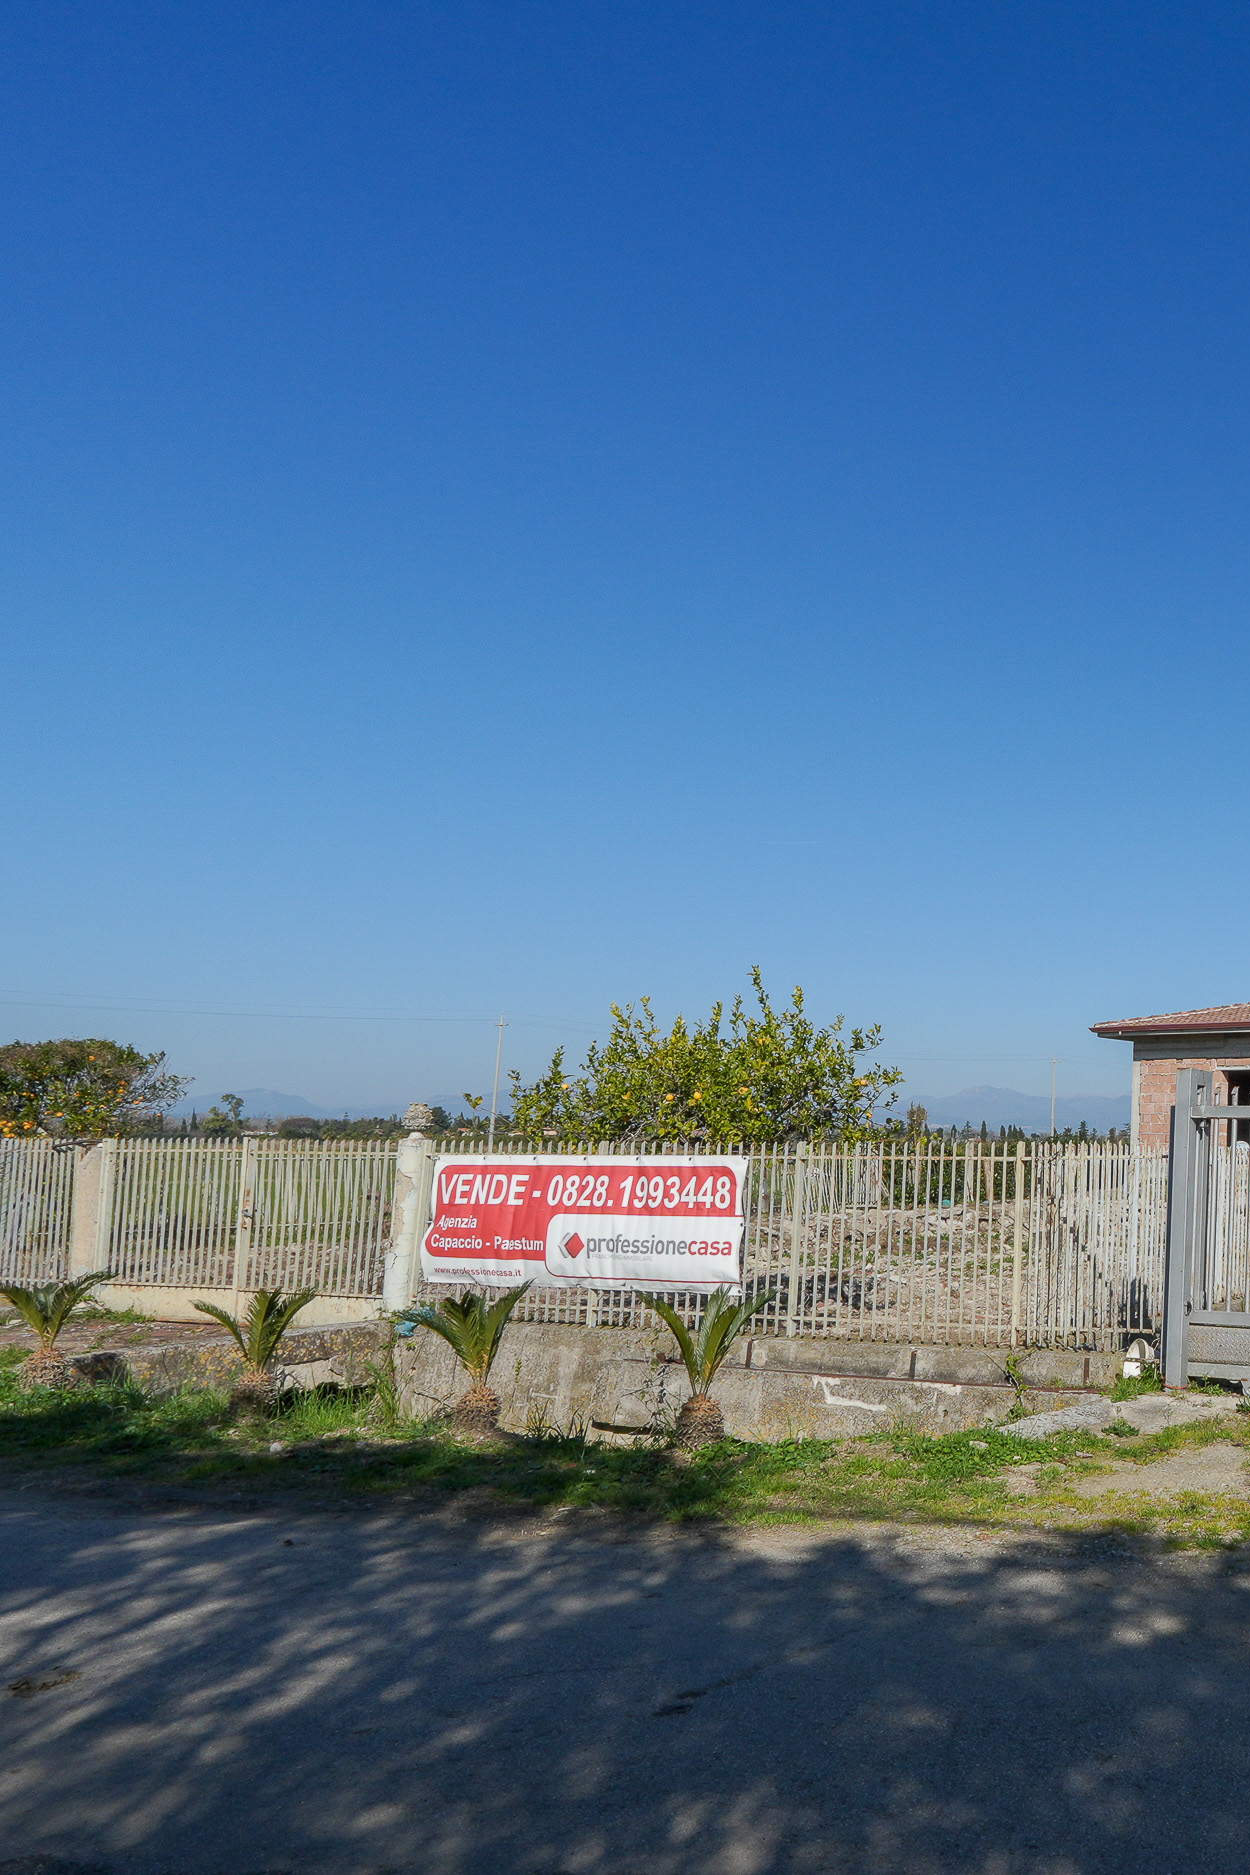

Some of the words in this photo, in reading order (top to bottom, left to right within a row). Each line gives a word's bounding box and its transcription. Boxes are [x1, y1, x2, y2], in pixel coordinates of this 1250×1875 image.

[440, 1174, 530, 1206] VENDE
[532, 1190, 542, 1198] -
[436, 1214, 478, 1230] Agenzia
[430, 1233, 483, 1251] Capaccio
[494, 1235, 544, 1251] Paestum
[586, 1233, 732, 1259] professionecasa
[433, 1266, 522, 1277] www.professionecasa.it
